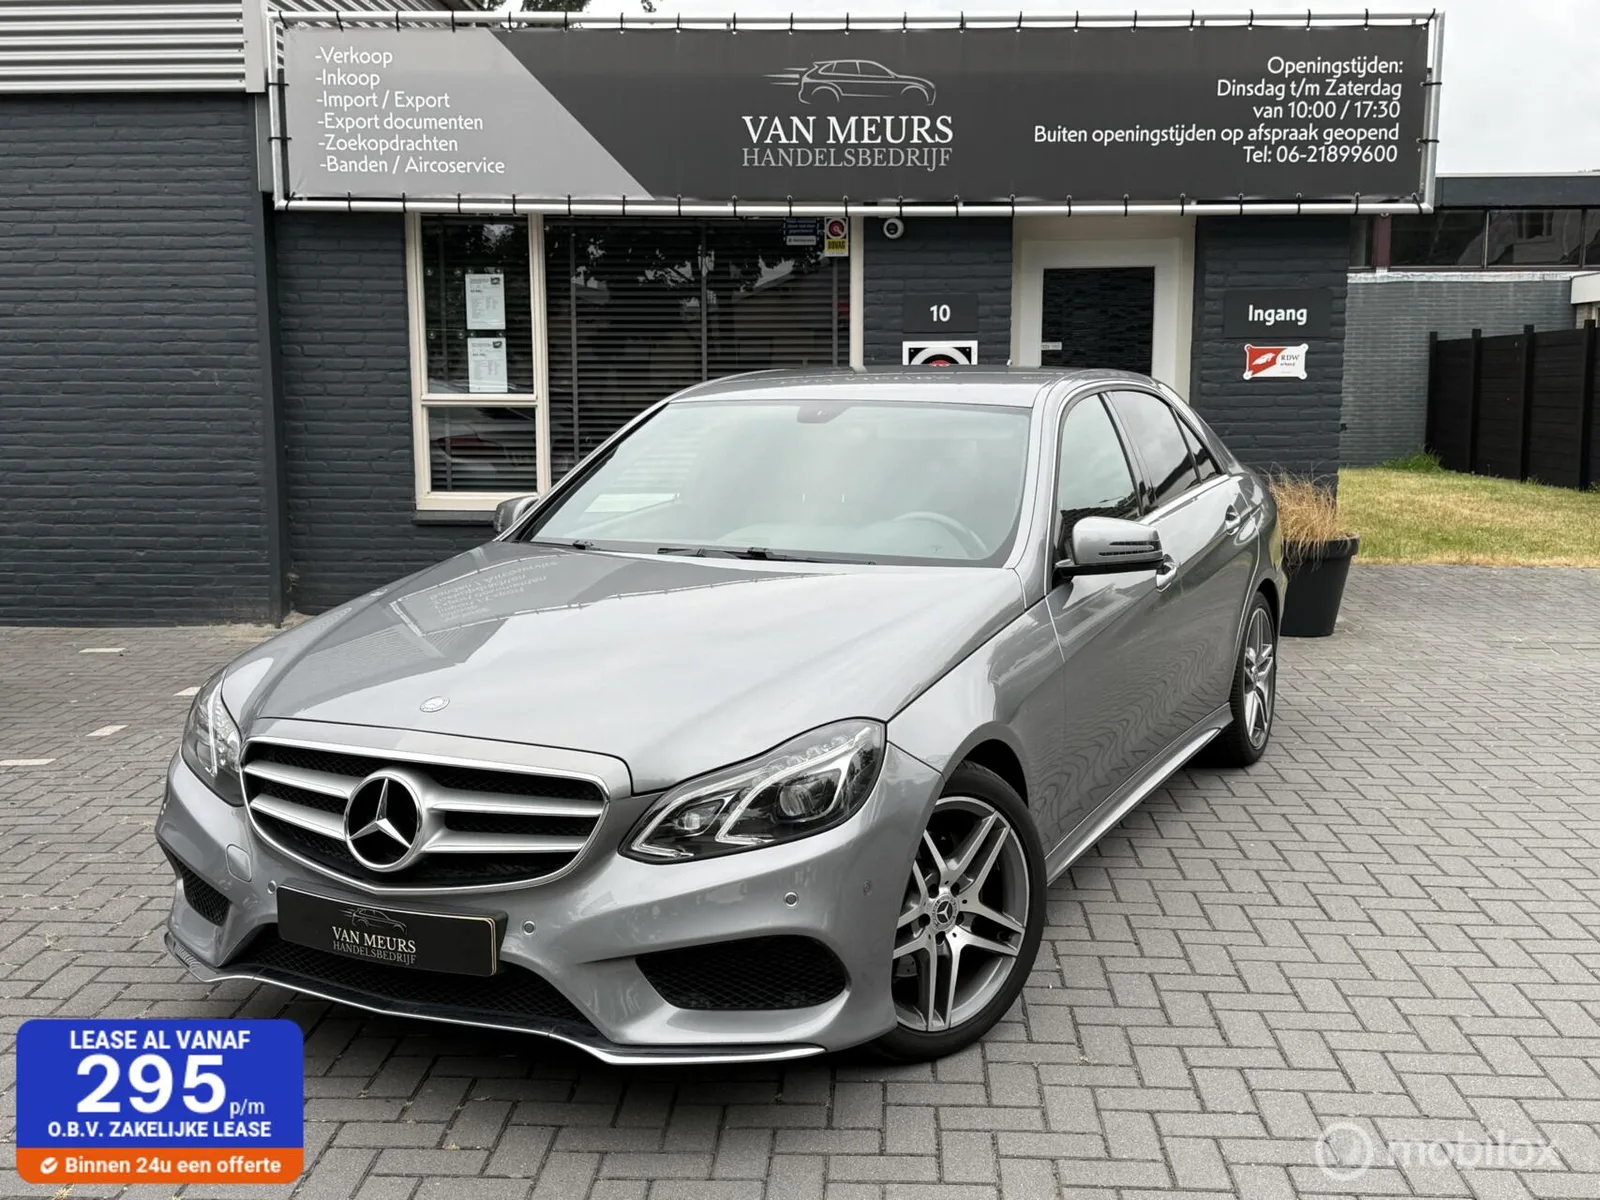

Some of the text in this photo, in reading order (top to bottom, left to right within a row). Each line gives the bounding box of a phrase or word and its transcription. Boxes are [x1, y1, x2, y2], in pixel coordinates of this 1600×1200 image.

[314, 46, 393, 69] -Verkoop
[1267, 56, 1404, 79] Openingstijden:
[315, 68, 381, 89] -Inkoop
[1217, 77, 1402, 101] Dinsdag t/m Zaterdag
[316, 88, 451, 112] -Import / Export
[1252, 100, 1401, 119] van 10:00 / 17:30
[317, 110, 483, 133] -Export documenten
[741, 116, 953, 143] VAN MEURS
[318, 132, 458, 156] -Zoekopdrachten
[1034, 123, 1400, 146] Buiten openingstijden op afspraak geopend
[319, 154, 505, 174] -Banden / Aircoservice
[742, 148, 953, 171] HANDELSBEDRIJF
[1242, 145, 1398, 162] Tel: 06-21899600
[929, 305, 951, 321] 10
[1248, 305, 1308, 325] Ingang
[332, 926, 416, 953] VAN MEURS
[333, 941, 416, 965] HANDELSBEDRIJF
